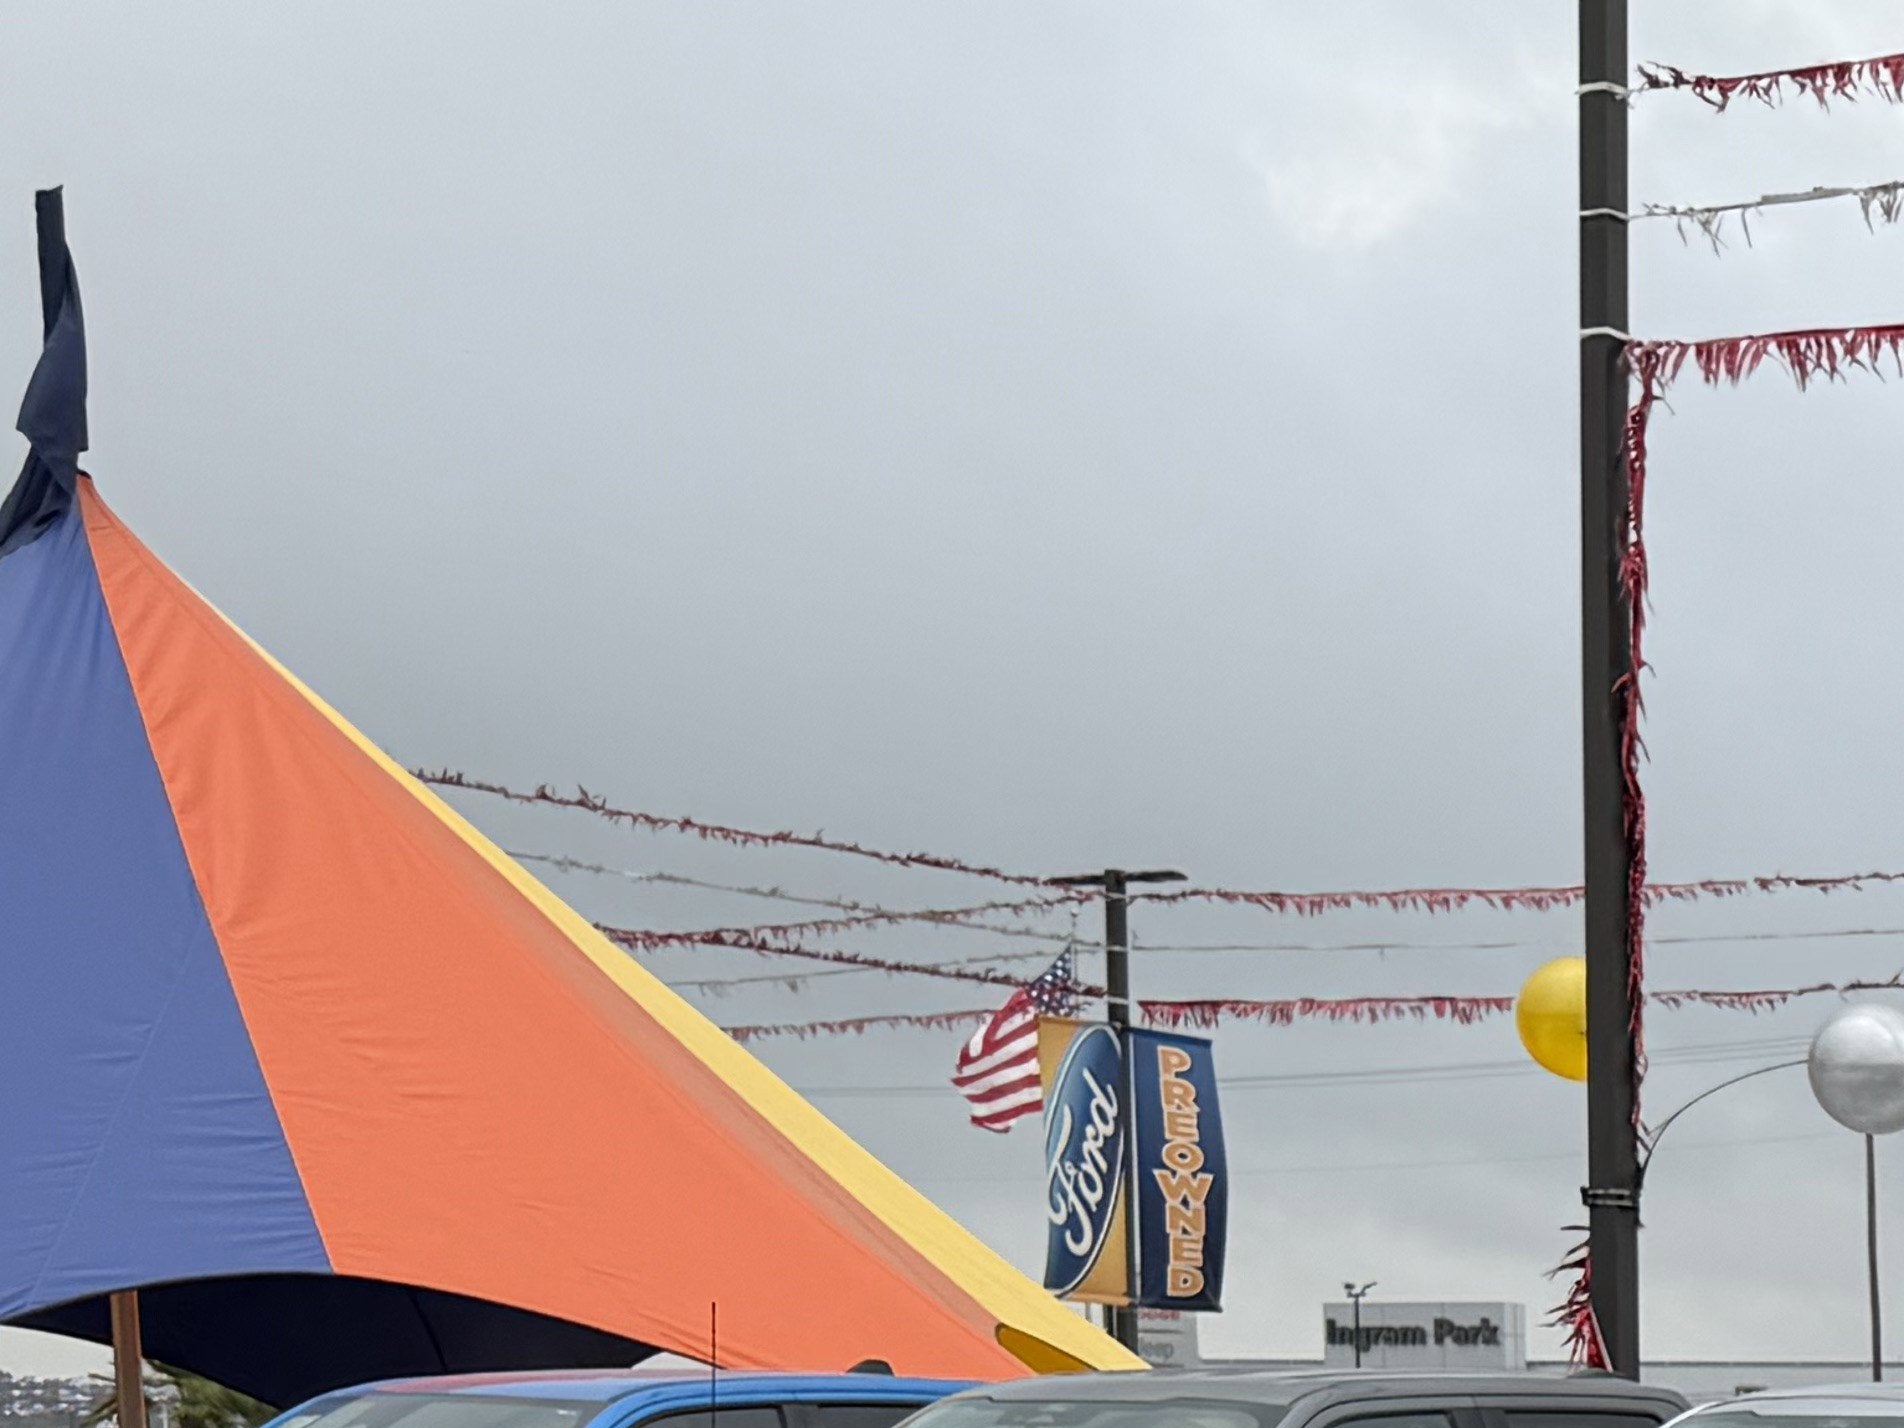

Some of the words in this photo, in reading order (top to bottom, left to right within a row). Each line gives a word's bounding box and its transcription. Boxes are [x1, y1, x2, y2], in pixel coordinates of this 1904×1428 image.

[1047, 1068, 1119, 1258] Ford
[1153, 1045, 1214, 1298] PREOWNED
[1326, 1318, 1428, 1352] Ingram
[1434, 1317, 1500, 1345] Park
